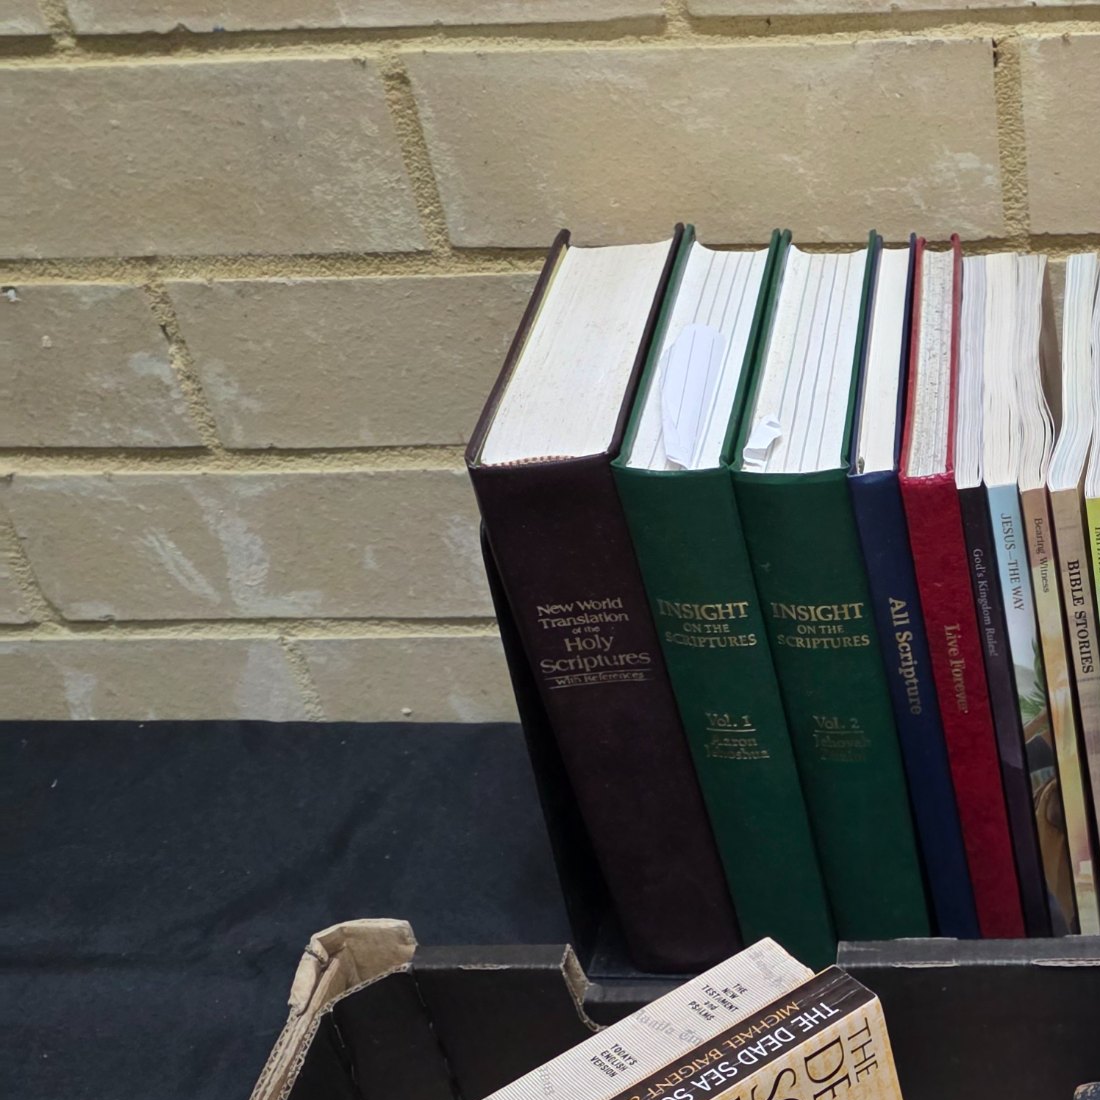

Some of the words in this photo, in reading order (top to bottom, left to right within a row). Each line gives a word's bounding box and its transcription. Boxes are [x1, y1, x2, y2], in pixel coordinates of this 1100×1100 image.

[1034, 517, 1045, 554] Bearing
[973, 548, 986, 579] God's
[1039, 556, 1049, 593] Witness
[1067, 560, 1085, 607] BIBLE
[537, 602, 574, 616] New
[576, 597, 623, 611] World
[657, 599, 749, 621] INSIGHT
[770, 602, 864, 622] INSIGHT
[889, 597, 908, 627] All
[977, 579, 992, 628] Kingdom
[1012, 586, 1025, 611] WAY
[538, 612, 629, 629] Translation
[683, 622, 702, 633] ON
[705, 623, 730, 634] THE
[797, 624, 817, 635] ON
[818, 624, 844, 634] THE
[564, 634, 614, 651] Holy
[665, 631, 757, 648] SCRIPTURES
[778, 634, 870, 649] SCRIPTURES
[944, 623, 962, 657] Live
[985, 628, 999, 657] Rules!
[1074, 609, 1095, 674] STORIES
[540, 652, 651, 674] Scriptures
[896, 630, 922, 716] Scripture
[950, 658, 968, 714] Forever
[701, 984, 739, 1013] TESTAMENT
[722, 987, 739, 999] NEW
[733, 983, 748, 995] THE
[688, 1000, 715, 1021] PSALMS
[704, 1001, 717, 1011] and
[790, 1002, 840, 1034] THE
[722, 1001, 801, 1050] MICHAEL
[610, 1043, 637, 1066] TODAY'S
[737, 1026, 796, 1066] DEAD
[847, 1017, 879, 1083] THE
[590, 1055, 618, 1078] VERSION
[600, 1049, 627, 1072] ENGLISH
[647, 1048, 724, 1100] BAIGENT
[691, 1060, 738, 1092] SEA
